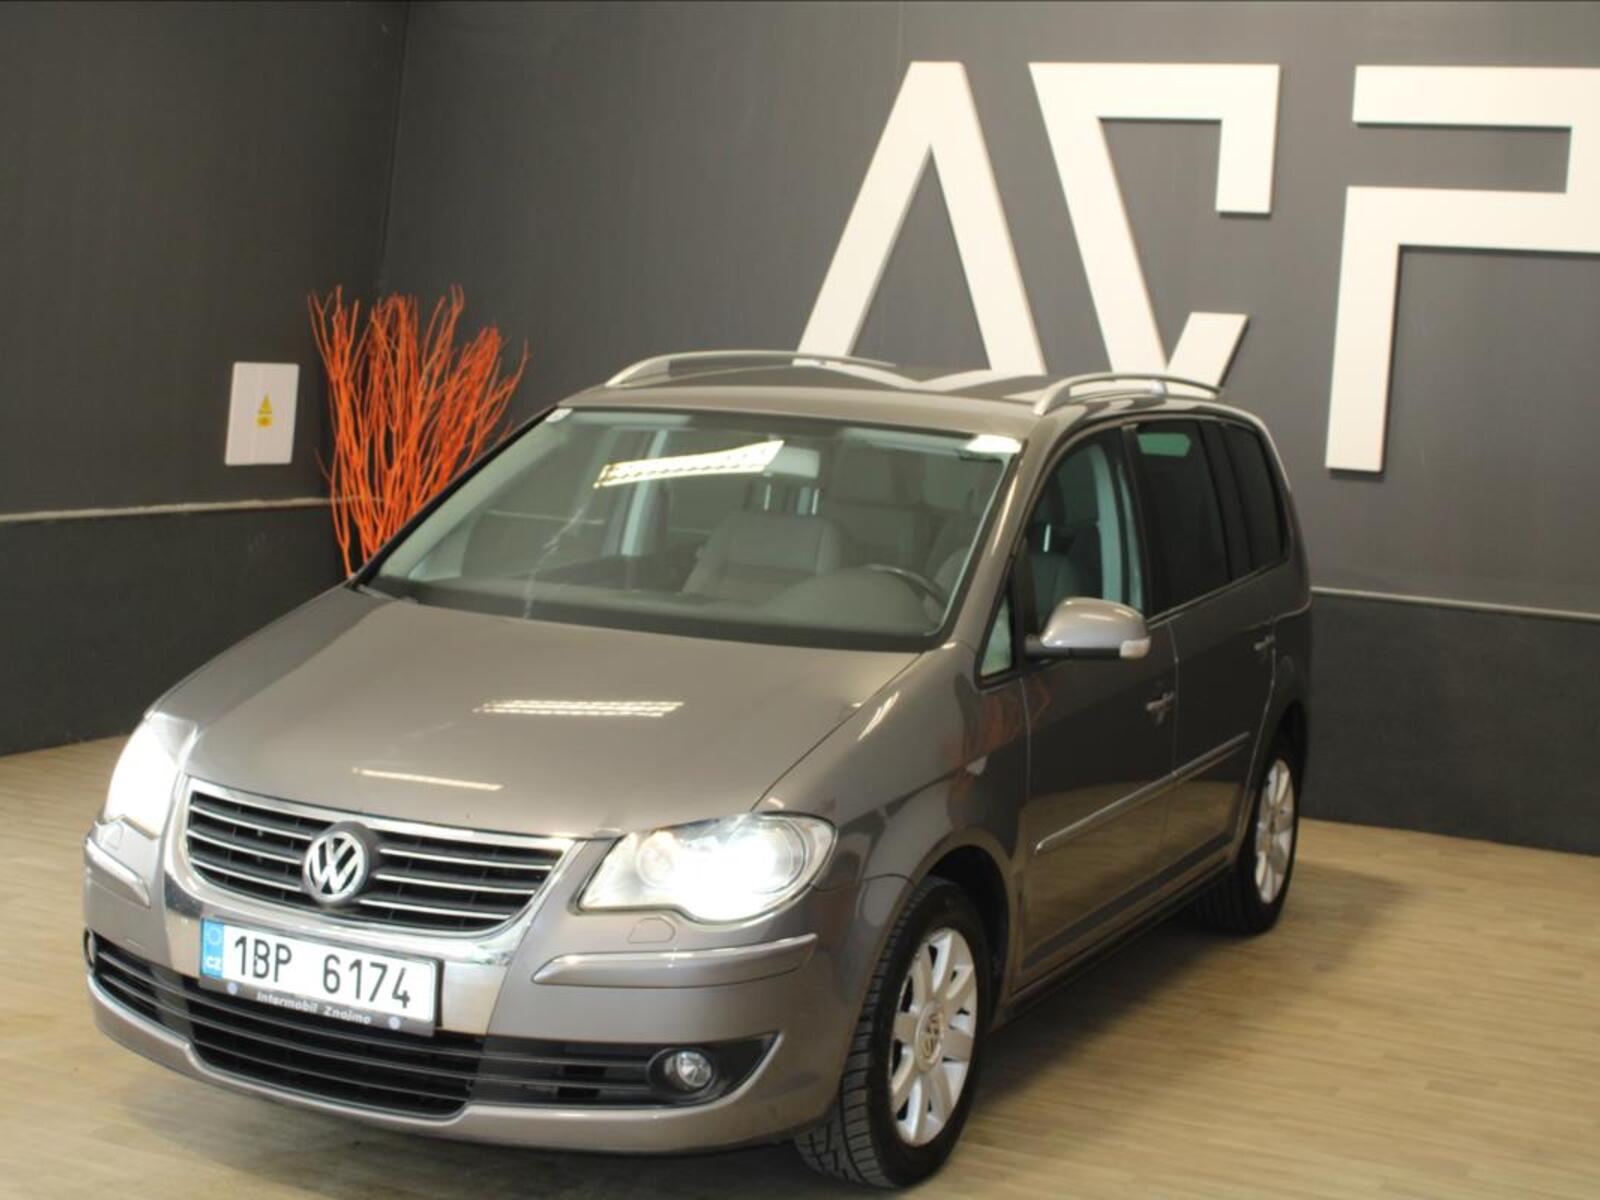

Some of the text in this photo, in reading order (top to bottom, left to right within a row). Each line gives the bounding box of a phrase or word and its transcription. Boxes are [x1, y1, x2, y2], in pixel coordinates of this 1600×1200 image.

[305, 832, 363, 901] VW
[234, 935, 411, 1008] 1BP 6174
[323, 1005, 372, 1025] Znojmo
